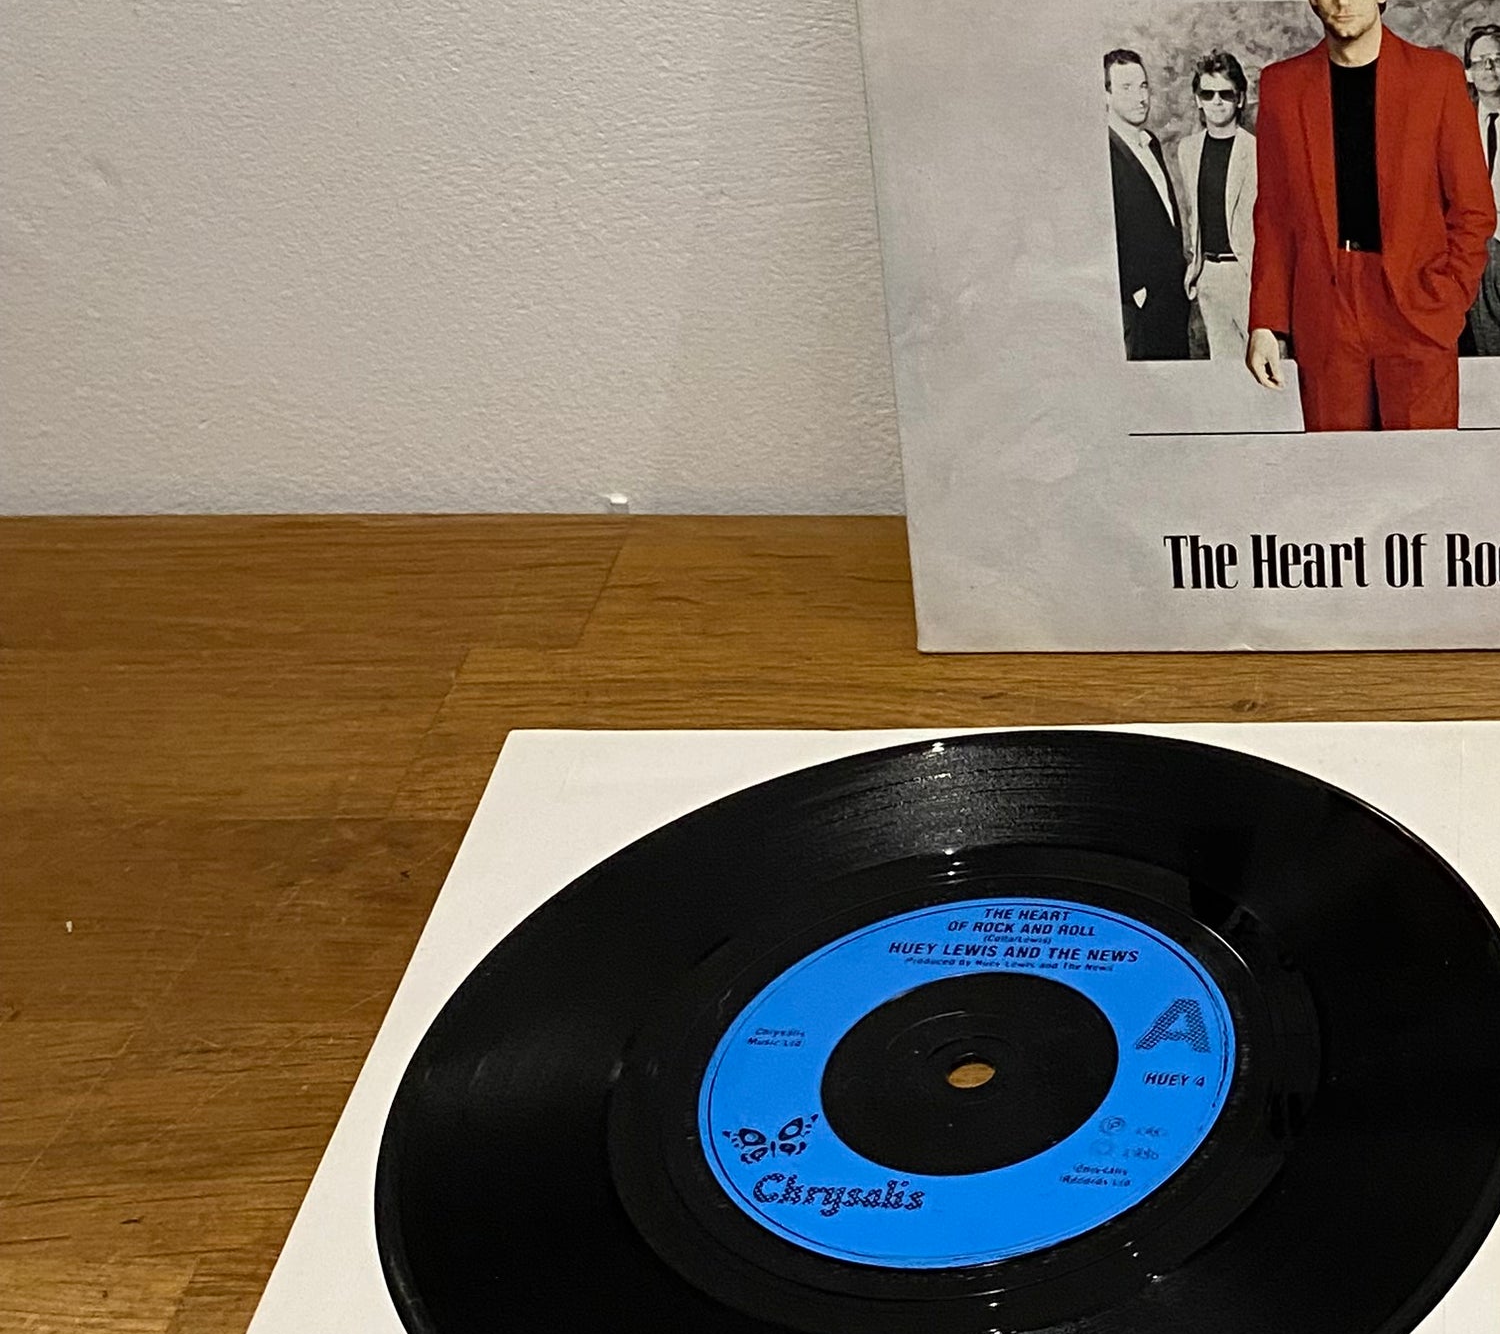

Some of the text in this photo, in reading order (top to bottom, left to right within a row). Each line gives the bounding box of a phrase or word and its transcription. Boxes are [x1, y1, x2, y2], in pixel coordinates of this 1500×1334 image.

[1163, 534, 1238, 589] The
[1250, 533, 1369, 589] Heart
[1385, 532, 1428, 588] Of
[983, 908, 1071, 921] THE HEART
[947, 920, 1096, 937] OF ROCK AND ROLL
[888, 942, 1139, 963] HUEY LEWIS AND THE NEWS
[1134, 998, 1212, 1053] A
[1144, 1072, 1206, 1088] HUEY 4
[753, 1172, 925, 1217] Chrysalis
